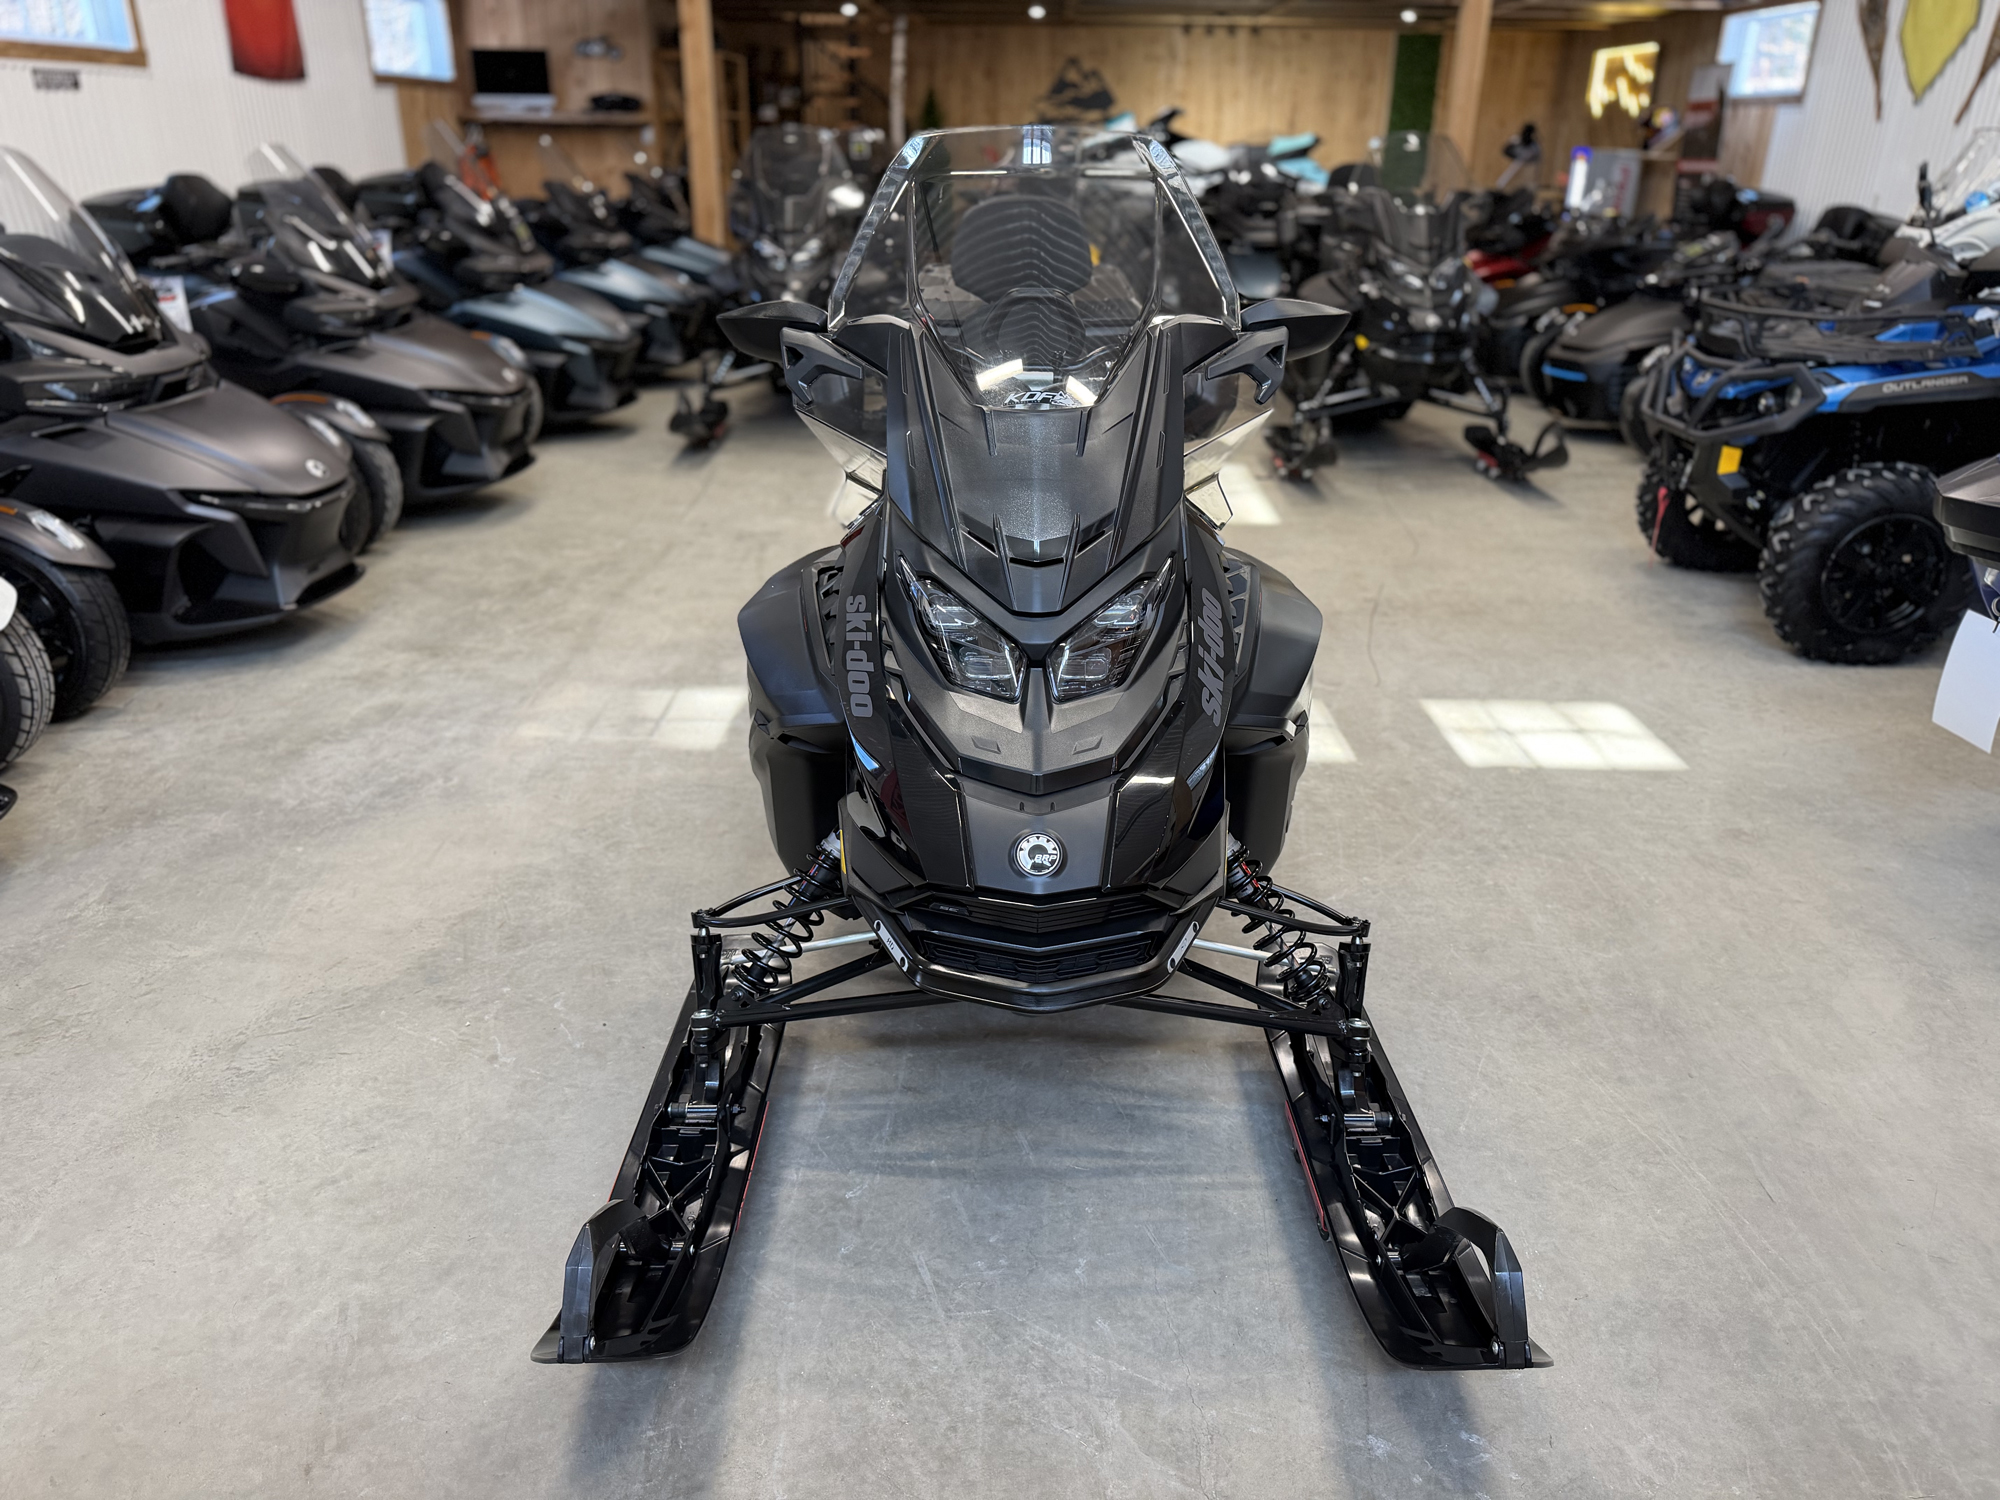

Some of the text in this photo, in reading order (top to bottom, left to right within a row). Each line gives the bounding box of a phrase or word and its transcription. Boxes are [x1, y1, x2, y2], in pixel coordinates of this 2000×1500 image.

[1882, 375, 1969, 393] OUTLANDER
[845, 594, 875, 718] ski-doo
[1197, 587, 1225, 728] ski-doo
[1034, 854, 1058, 867] BRP
